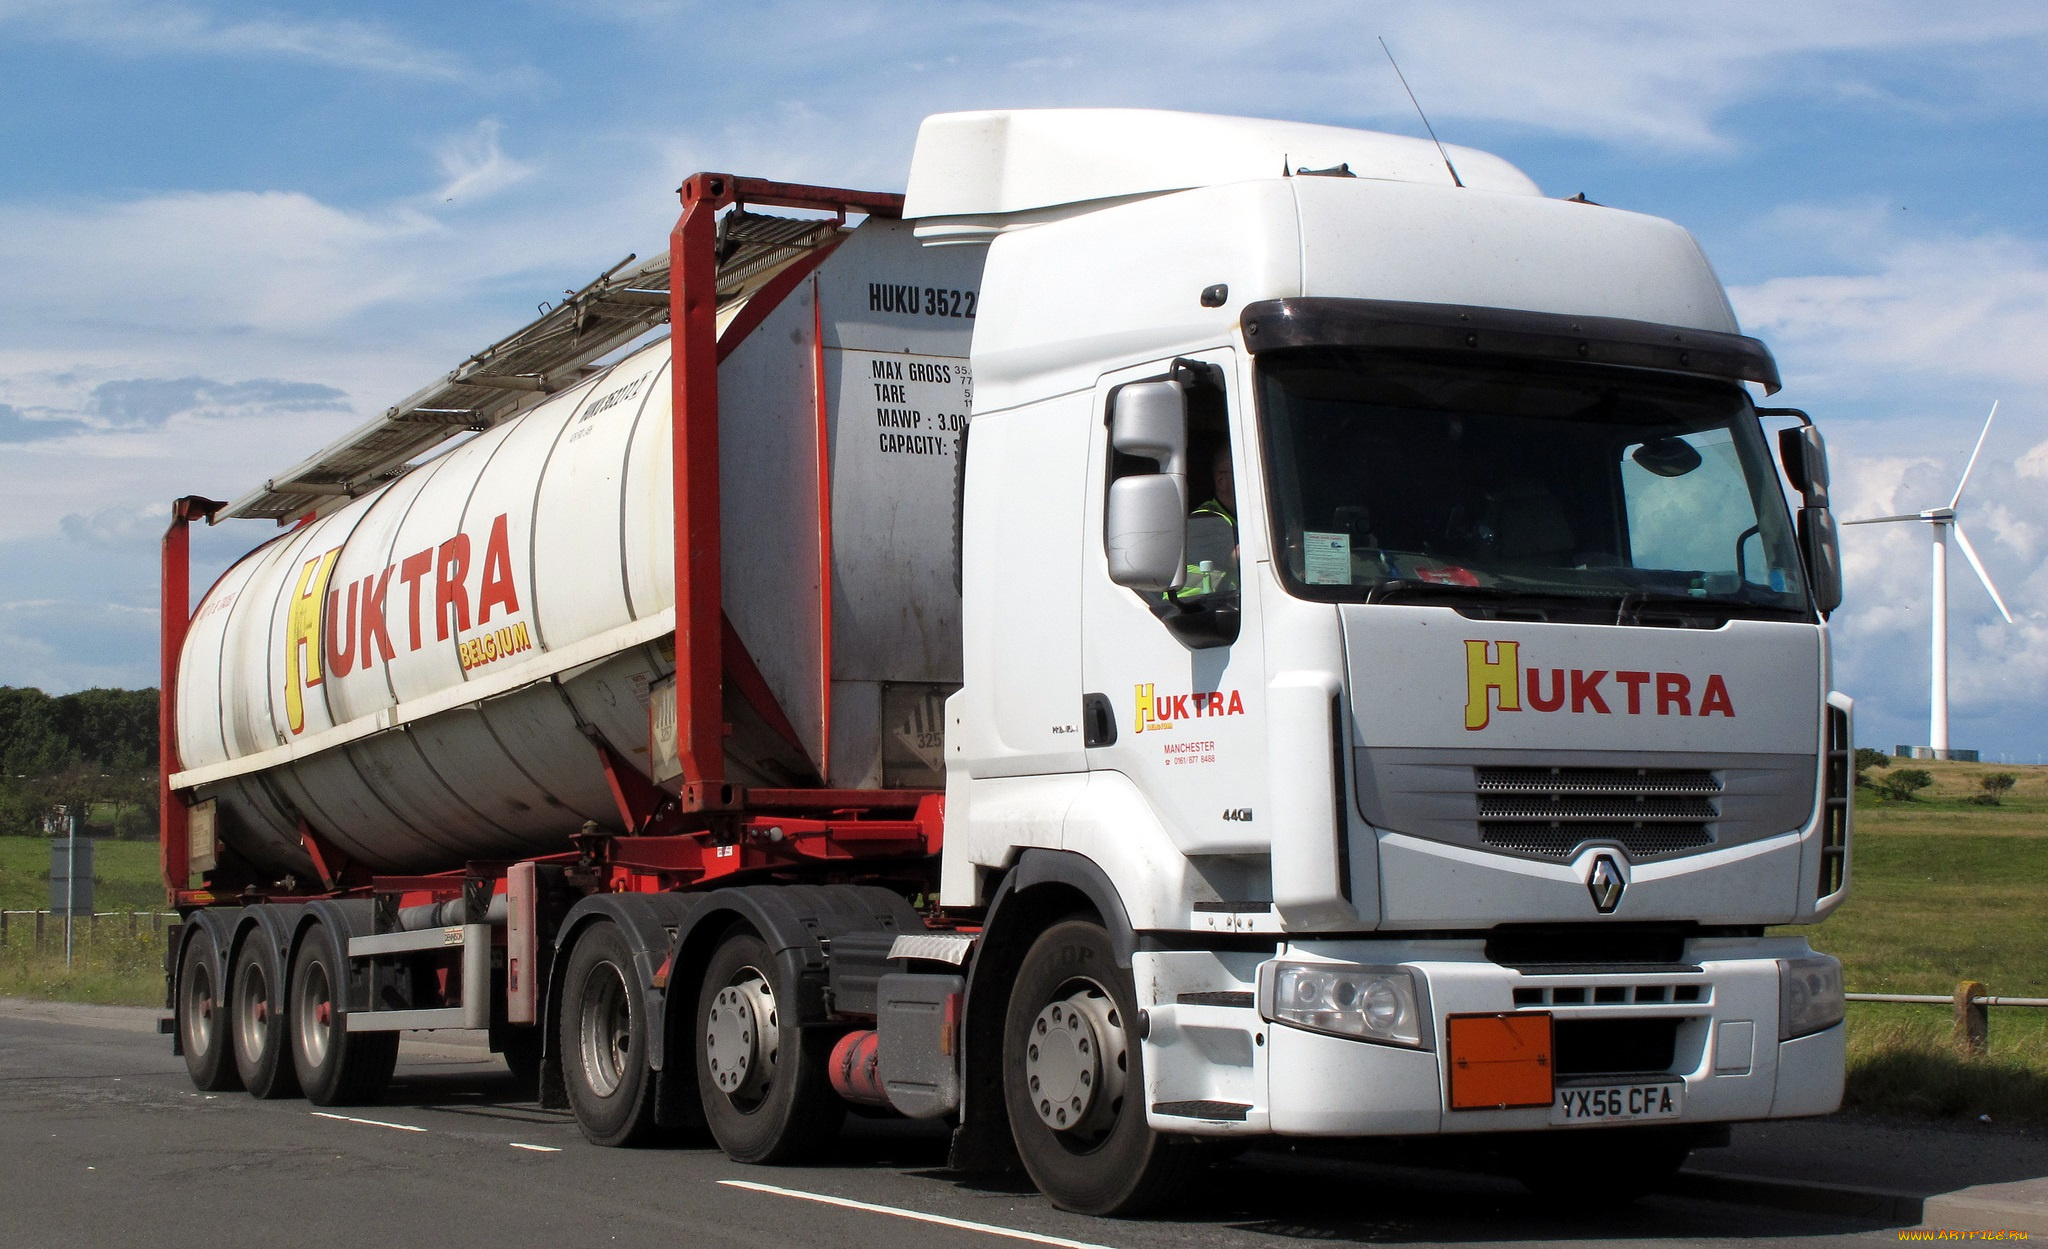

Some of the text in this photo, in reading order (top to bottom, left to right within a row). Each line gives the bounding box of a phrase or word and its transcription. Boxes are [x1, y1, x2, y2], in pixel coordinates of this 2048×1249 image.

[869, 282, 979, 319] HUKU 3522
[872, 360, 972, 384] MAX GROSS 35.
[960, 376, 973, 385] 77
[874, 383, 974, 404] TARE 5.
[964, 399, 973, 408] 11
[877, 408, 921, 429] MAWP
[879, 433, 948, 456] CAPACITY:
[284, 512, 520, 735] HUKTRA
[459, 620, 532, 672] BELGIUM
[1463, 639, 1736, 731] HUKTRA
[1134, 683, 1245, 734] HUKTRA
[917, 731, 943, 749] 325
[1163, 741, 1216, 755] MANCHESTER
[1561, 1086, 1673, 1118] YX56 CFA
